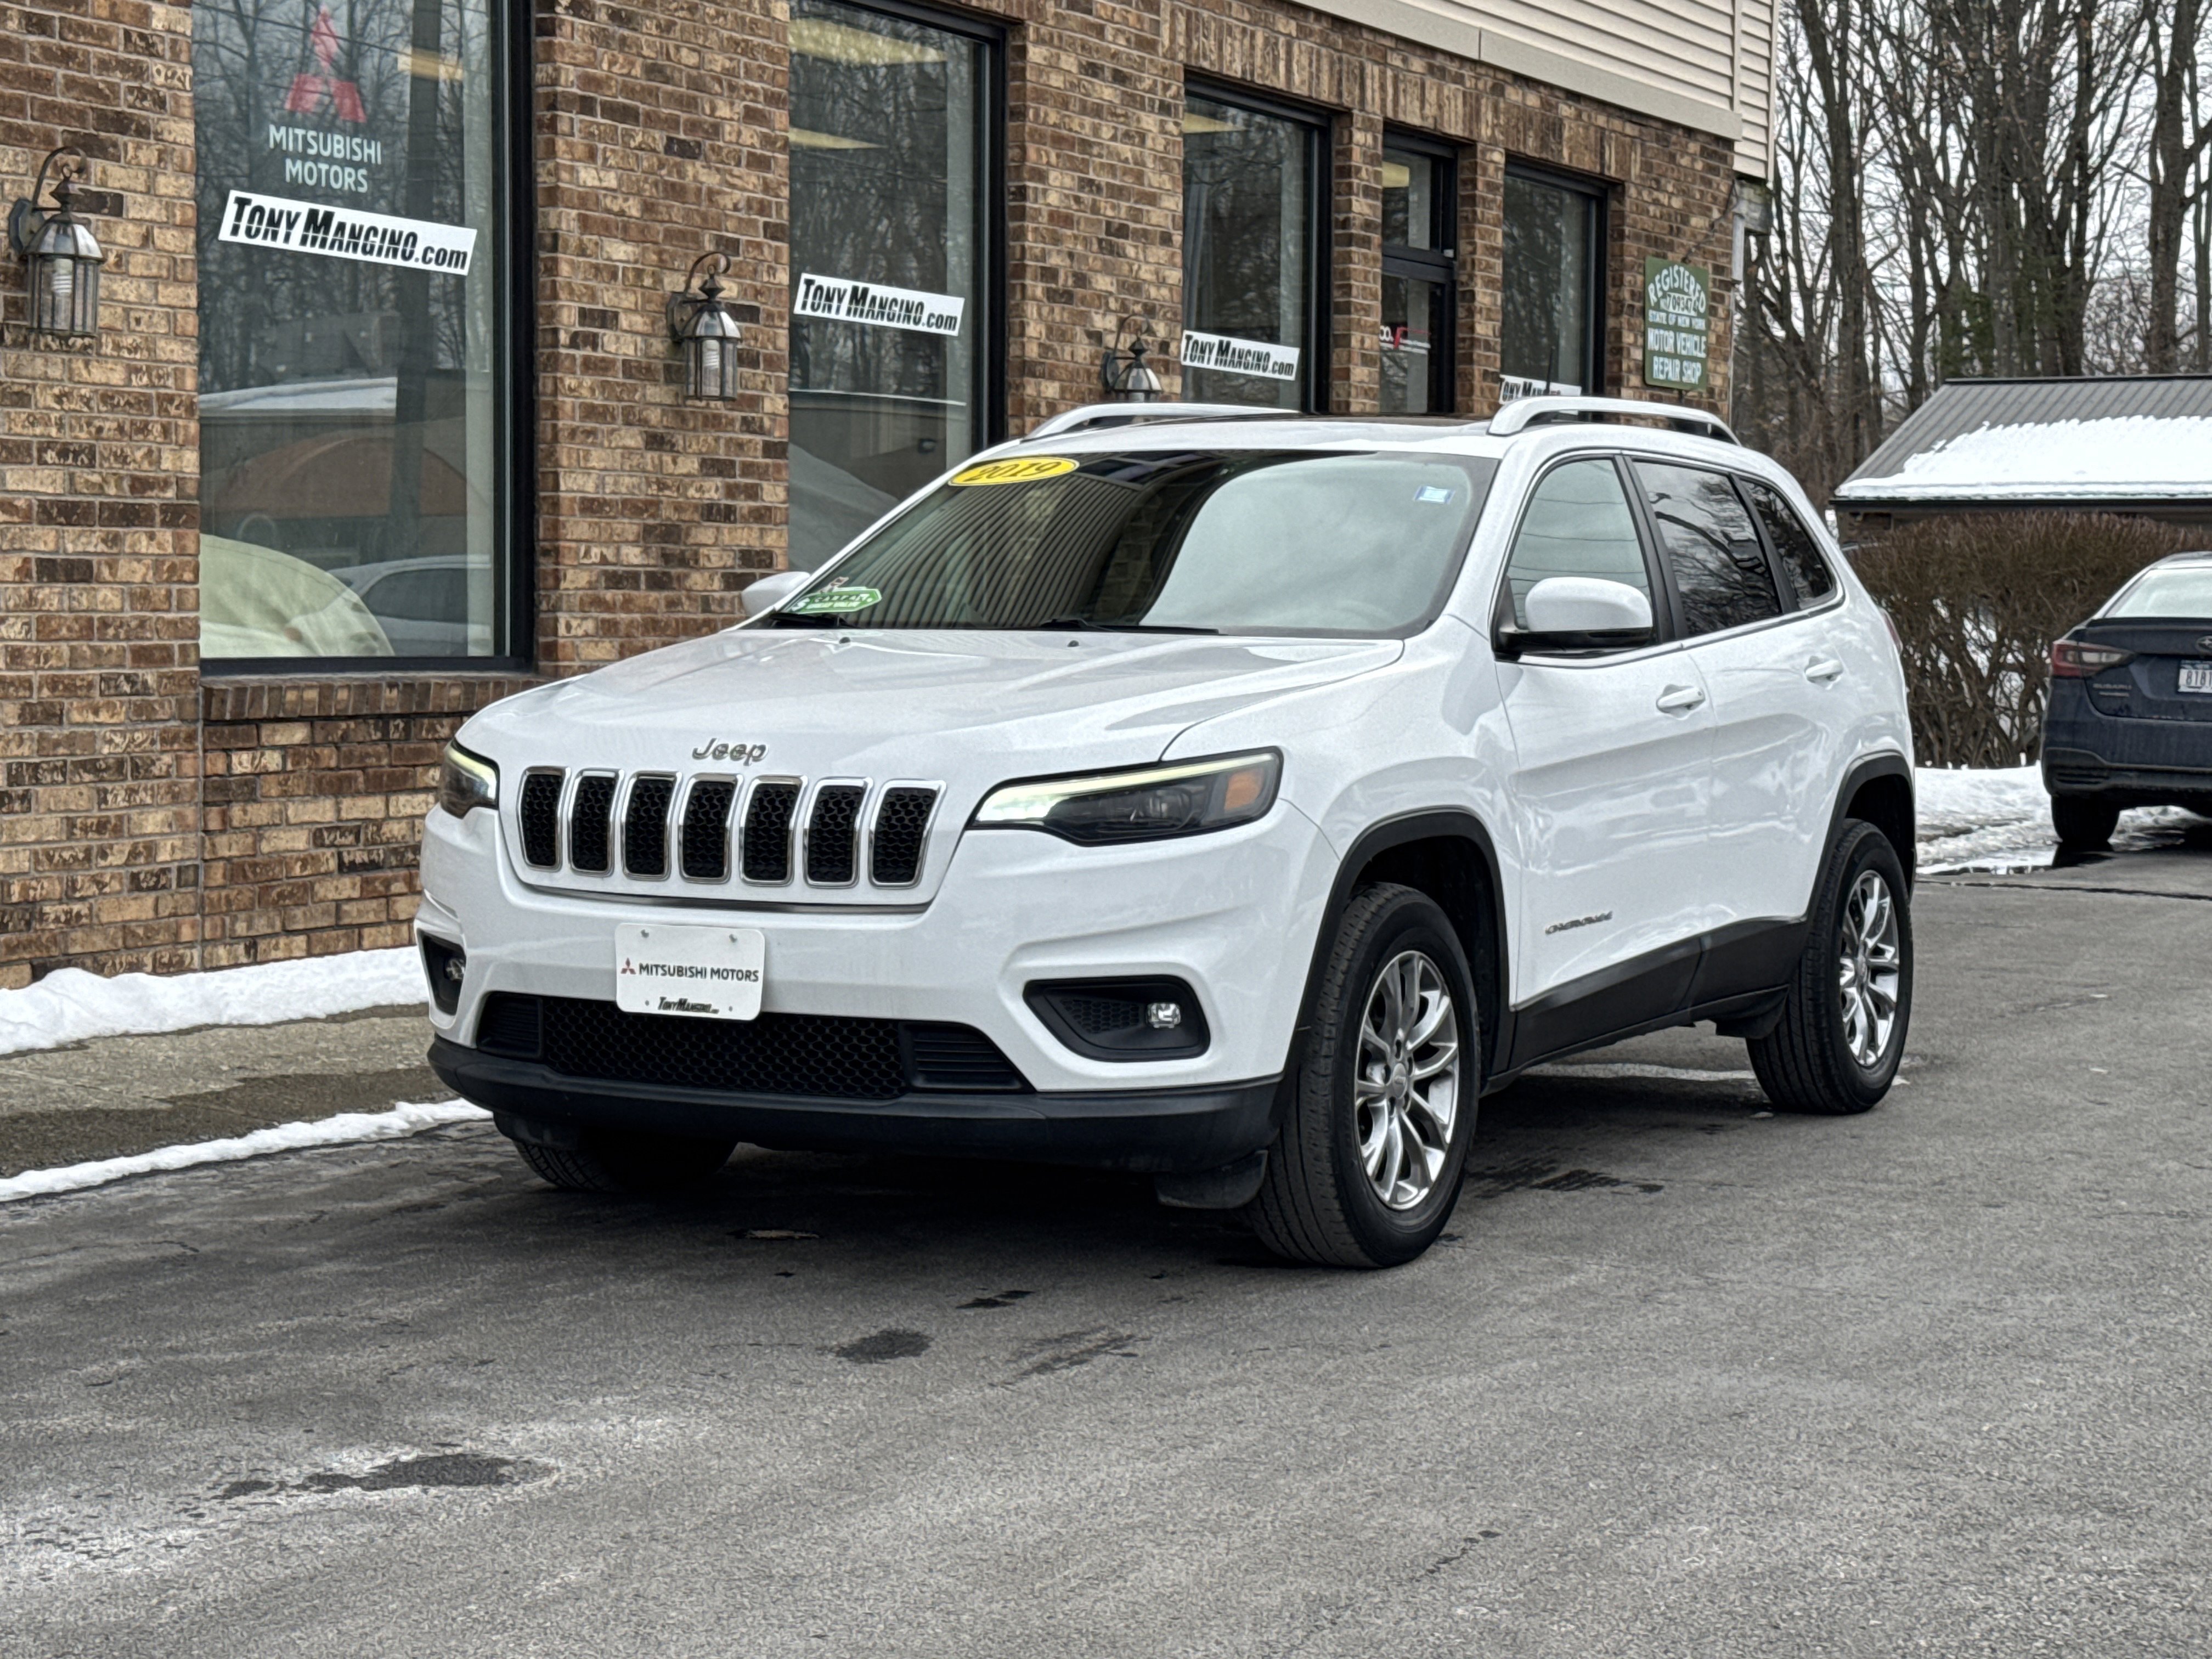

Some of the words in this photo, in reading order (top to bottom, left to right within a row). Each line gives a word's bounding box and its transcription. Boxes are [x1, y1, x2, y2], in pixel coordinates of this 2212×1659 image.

[268, 124, 382, 165] MITSUBISHI
[285, 158, 369, 194] MOTORS
[230, 196, 302, 245] TONY
[800, 278, 848, 315] TONY
[1652, 356, 1681, 382] REPAIR
[963, 461, 1062, 482] 2019
[692, 737, 769, 766] Jeep
[639, 963, 707, 979] MITSUBISHI
[710, 967, 759, 982] MOTORS
